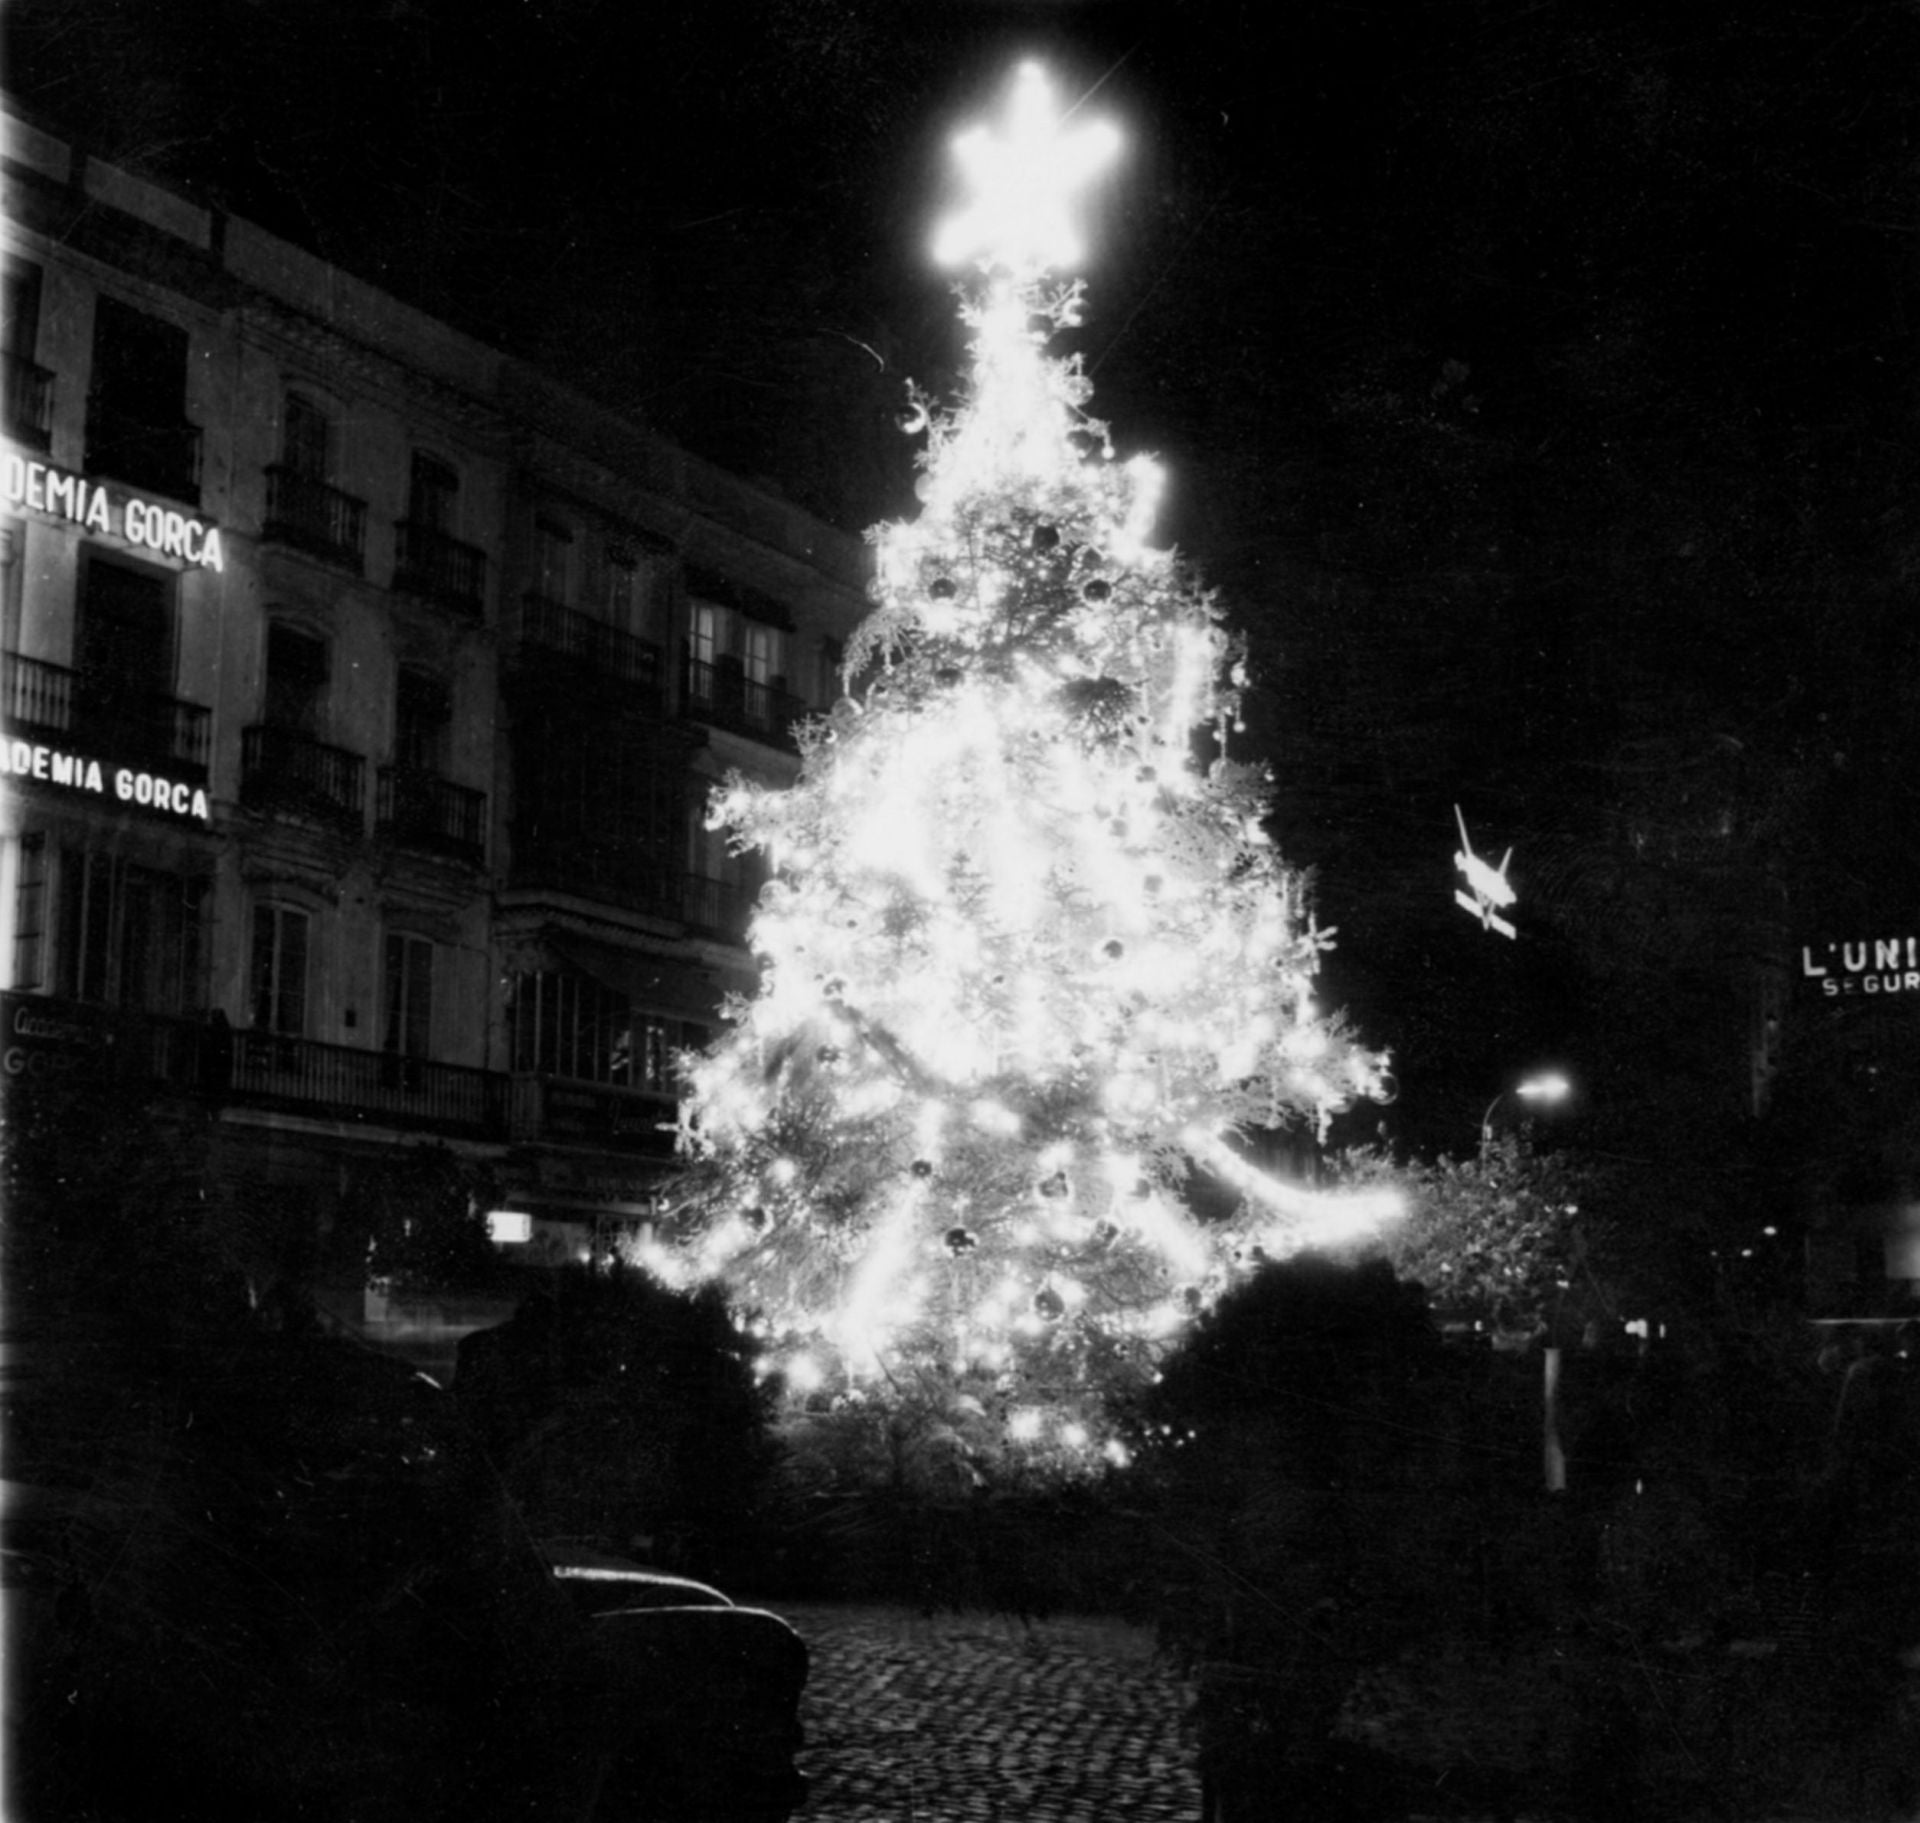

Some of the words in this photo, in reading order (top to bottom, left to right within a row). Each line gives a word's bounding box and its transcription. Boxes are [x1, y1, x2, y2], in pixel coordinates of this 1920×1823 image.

[2, 454, 109, 533] DEMIA
[125, 499, 223, 572] GORCA
[115, 768, 209, 820] GORCA
[1803, 937, 1916, 976] L'UNI
[1822, 971, 1920, 996] SEGUR
